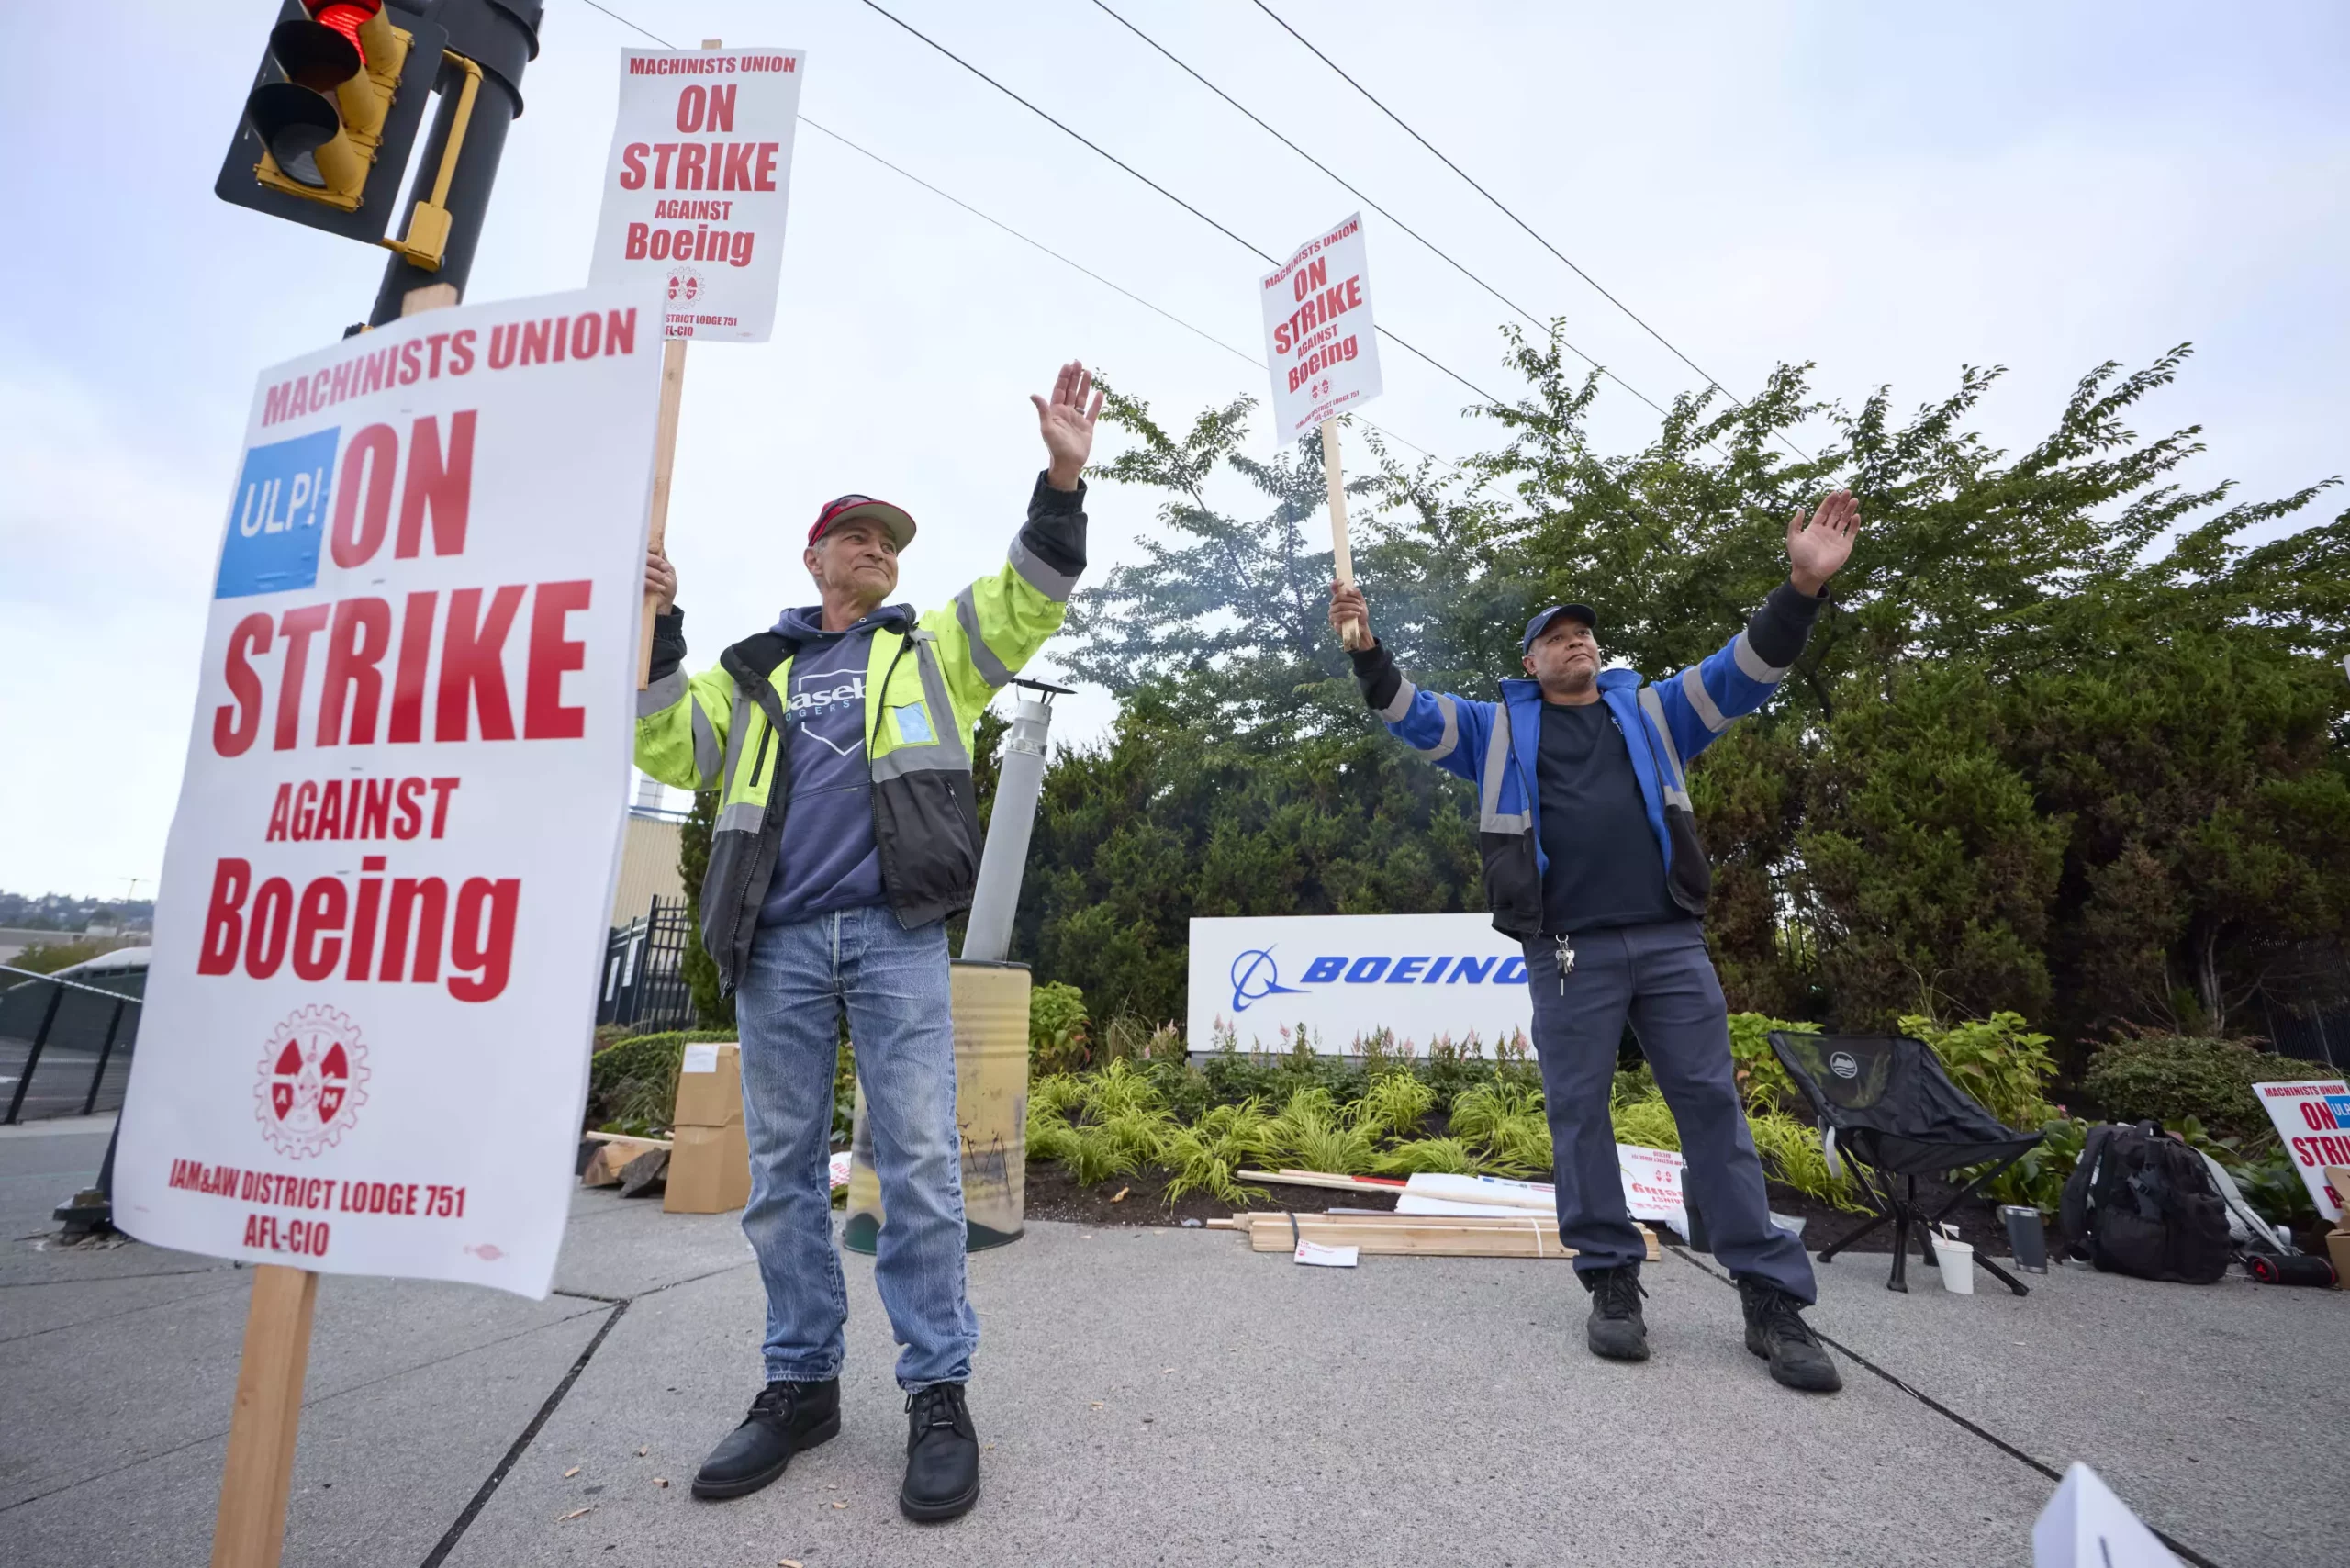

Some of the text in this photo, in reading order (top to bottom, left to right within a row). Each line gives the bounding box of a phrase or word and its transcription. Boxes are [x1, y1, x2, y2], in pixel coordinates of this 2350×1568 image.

[630, 56, 797, 75] MACHINISTS UNION
[676, 84, 738, 134] ON
[620, 142, 779, 192] STRIKE
[655, 200, 733, 220] AGAINST
[625, 222, 755, 267] Boeing
[1264, 220, 1358, 289] MACHINISTS UNION
[1293, 256, 1327, 303] ON
[666, 313, 738, 327] STRICT LODGE 751
[666, 325, 694, 337] FL-CIO
[1274, 274, 1363, 355] STRIKE
[1288, 334, 1359, 394] Boeing
[1297, 323, 1338, 361] AGAINST
[261, 308, 637, 428] MACHINISTS UNION
[240, 467, 323, 538] ULP!
[330, 409, 478, 569] ON
[212, 579, 593, 758] STRIKE
[265, 777, 461, 842] AGAINST
[196, 856, 521, 1003] Boeing
[1299, 956, 1528, 984] BOEING
[2264, 1085, 2346, 1097] MACHINISTS UNION
[2300, 1102, 2339, 1131] ON
[168, 1158, 466, 1218] IAM&AW DISTRICT LODGE 751
[243, 1214, 330, 1258] AFL-CIO
